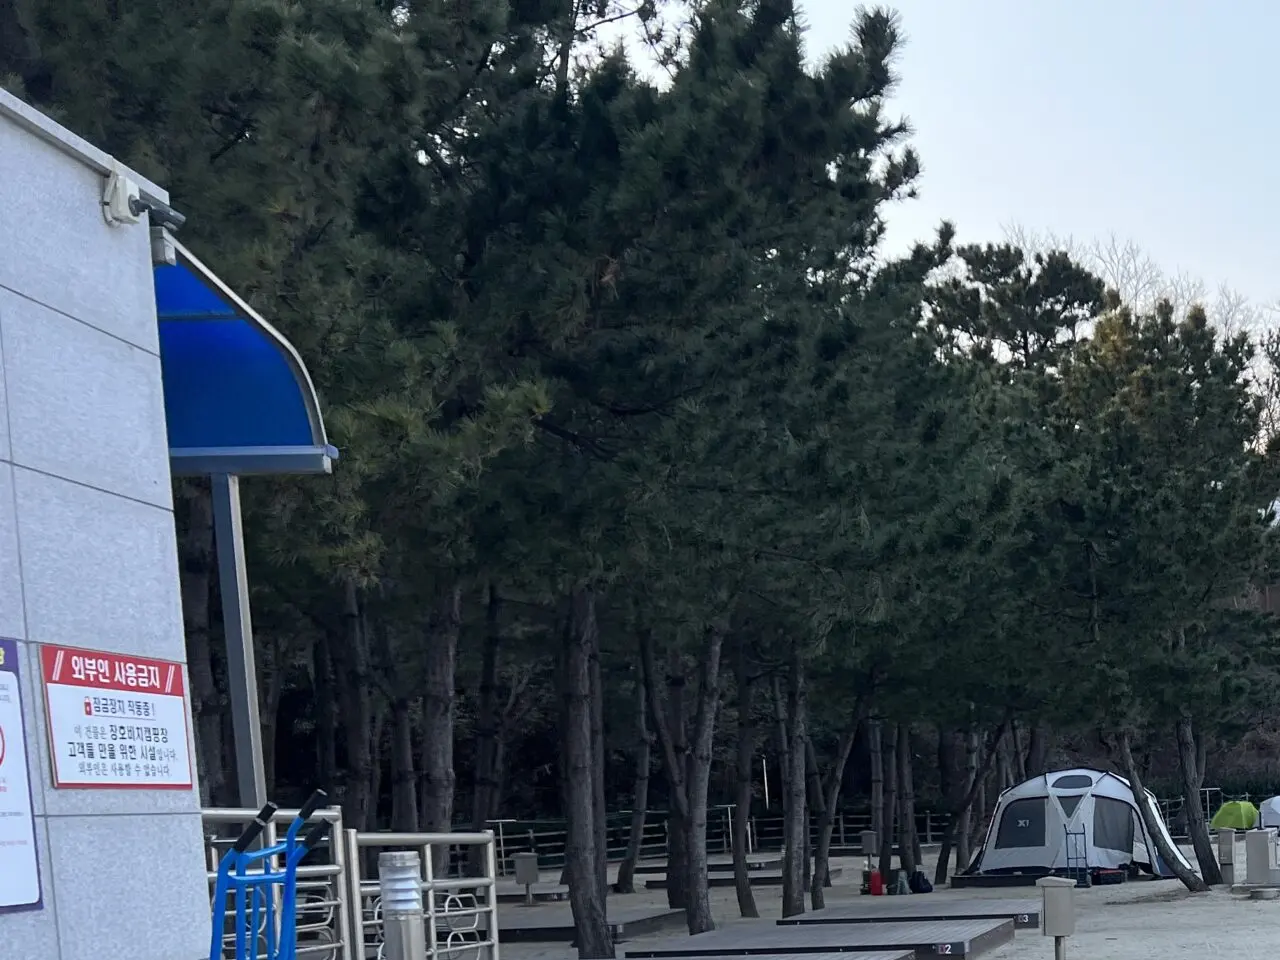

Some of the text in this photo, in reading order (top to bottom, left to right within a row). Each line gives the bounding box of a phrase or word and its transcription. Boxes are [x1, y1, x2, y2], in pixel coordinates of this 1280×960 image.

[71, 656, 160, 688] 외부인 사용금지
[93, 697, 125, 714] 잠금장치
[119, 744, 137, 760] 위한
[134, 764, 142, 777] 수
